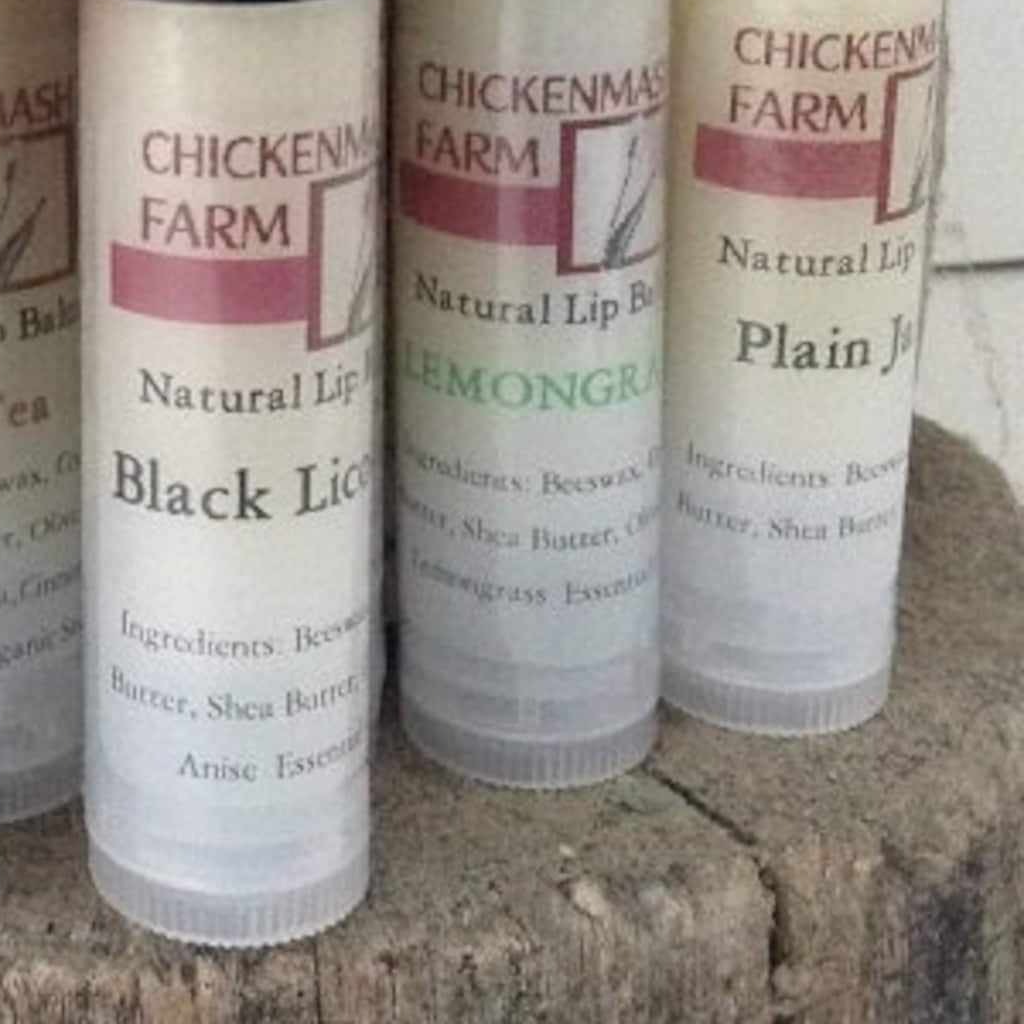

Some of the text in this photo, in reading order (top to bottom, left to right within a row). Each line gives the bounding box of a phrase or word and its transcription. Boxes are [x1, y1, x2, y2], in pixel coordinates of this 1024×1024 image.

[729, 83, 868, 133] FARM
[416, 120, 540, 177] FARM
[140, 196, 291, 250] FARM
[717, 233, 915, 278] Natural Lip
[414, 273, 550, 326] Natural
[564, 291, 619, 332] Lip
[736, 317, 870, 370] Plain
[138, 367, 302, 414] Natural
[314, 364, 360, 407] Lip
[113, 449, 273, 520] Black
[462, 517, 519, 548] Shea
[677, 491, 759, 538] Butter,
[767, 517, 827, 541] Shea
[110, 665, 198, 720] Butter,
[207, 693, 274, 721] Shea
[179, 752, 257, 782] Anise
